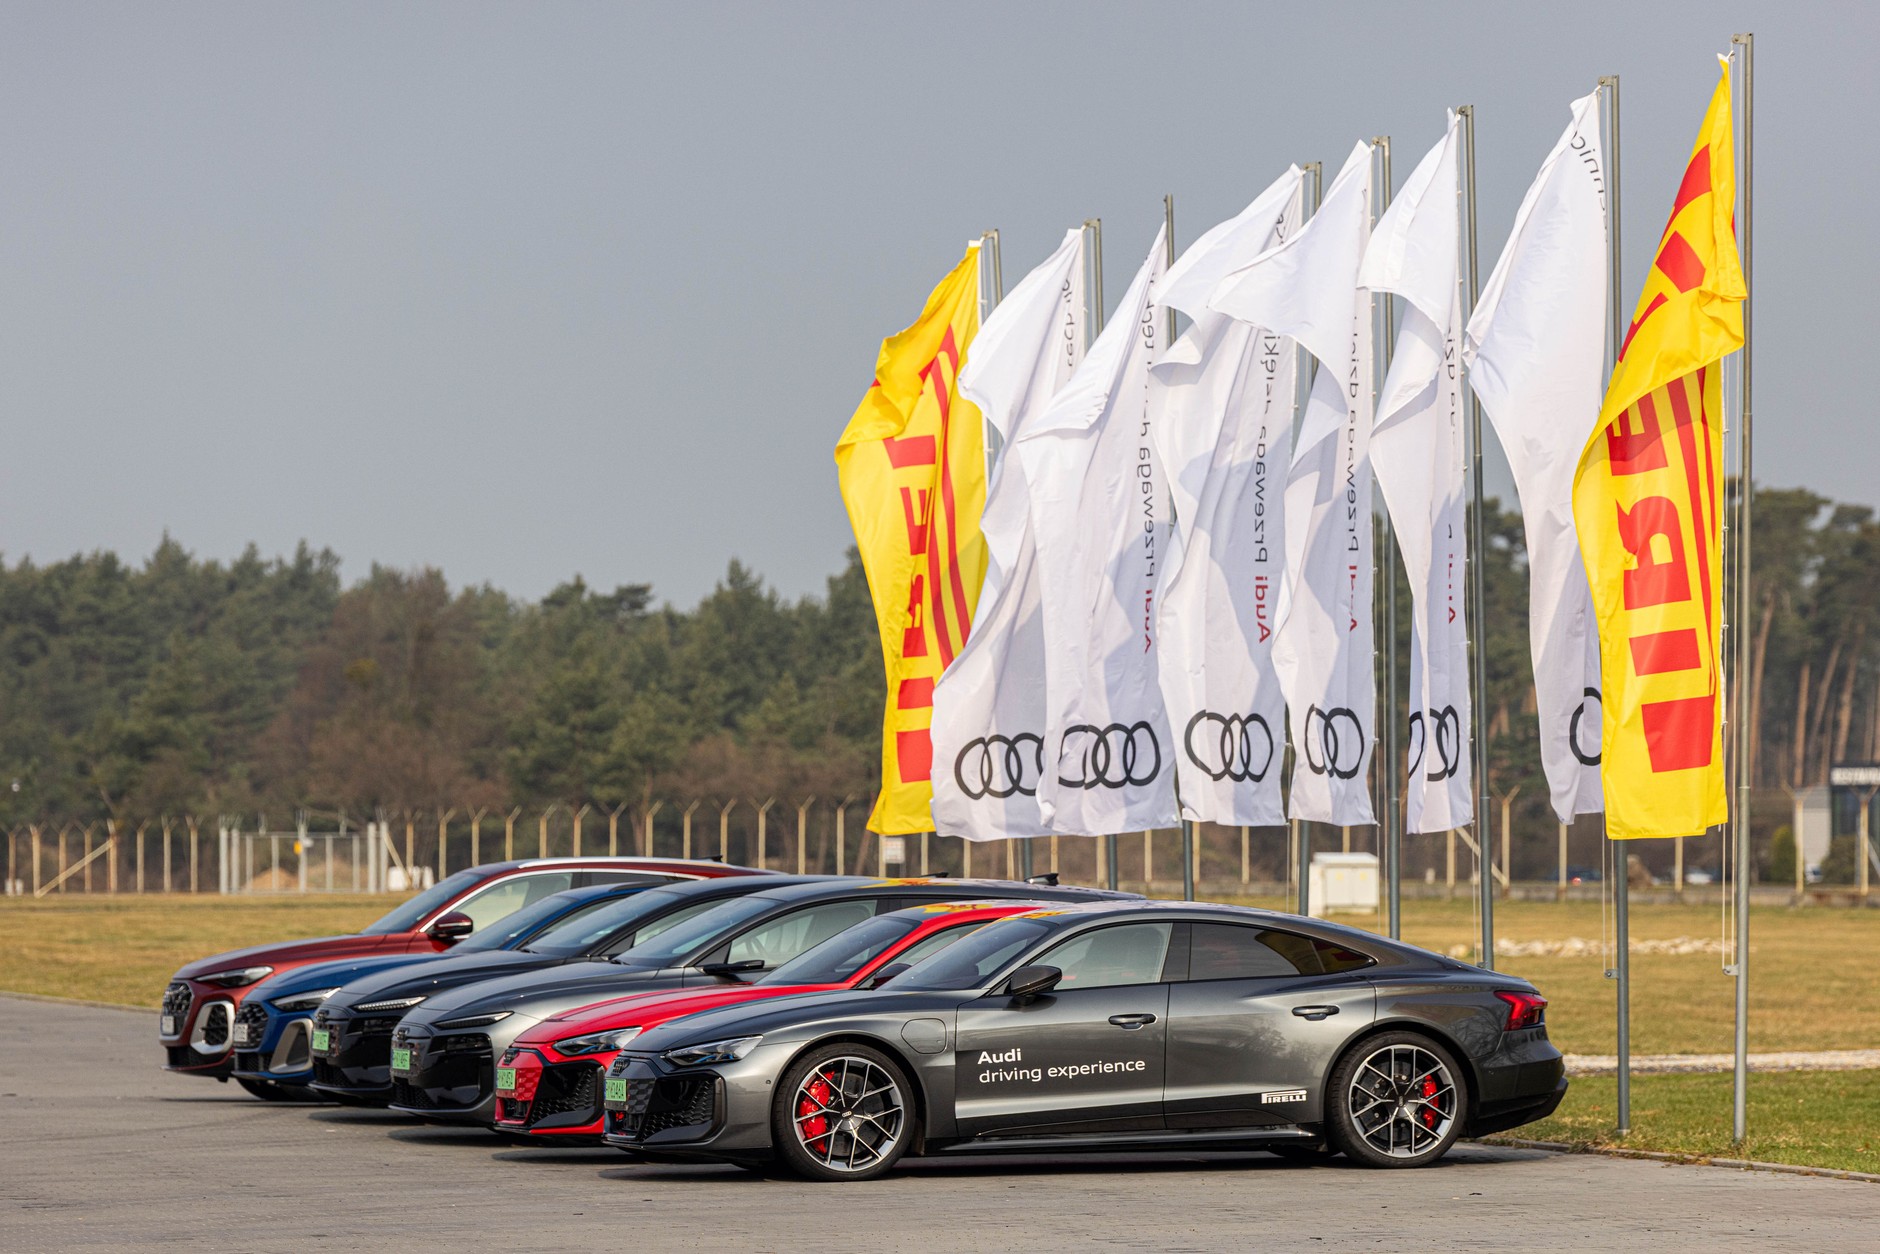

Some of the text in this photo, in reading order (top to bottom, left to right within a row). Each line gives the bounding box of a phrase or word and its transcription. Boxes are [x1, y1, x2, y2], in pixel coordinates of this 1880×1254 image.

[977, 1048, 1022, 1065] Audi
[978, 1060, 1146, 1084] driving experience
[1261, 1090, 1307, 1104] PIRELLI
